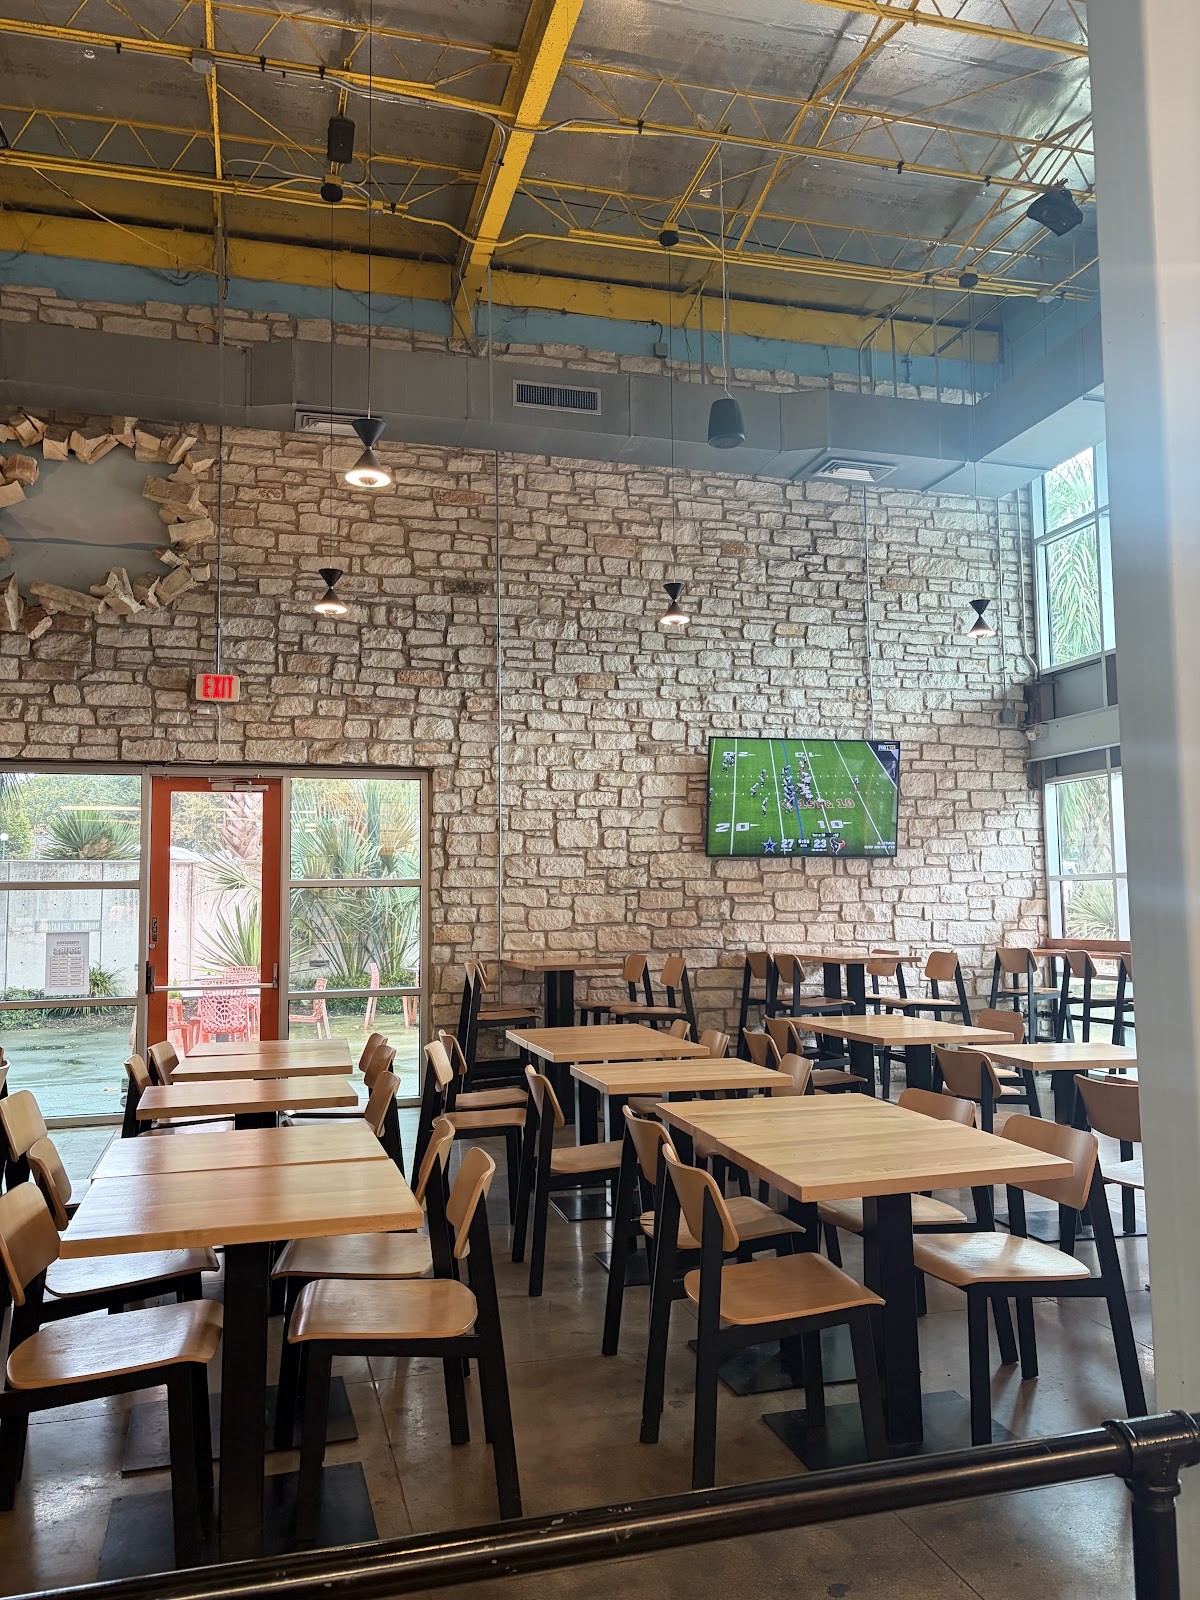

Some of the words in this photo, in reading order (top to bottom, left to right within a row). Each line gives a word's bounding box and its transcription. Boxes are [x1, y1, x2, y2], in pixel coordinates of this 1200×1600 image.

[202, 674, 234, 699] EXIT
[836, 797, 856, 809] 10
[781, 839, 795, 848] 27
[813, 838, 827, 848] 23
